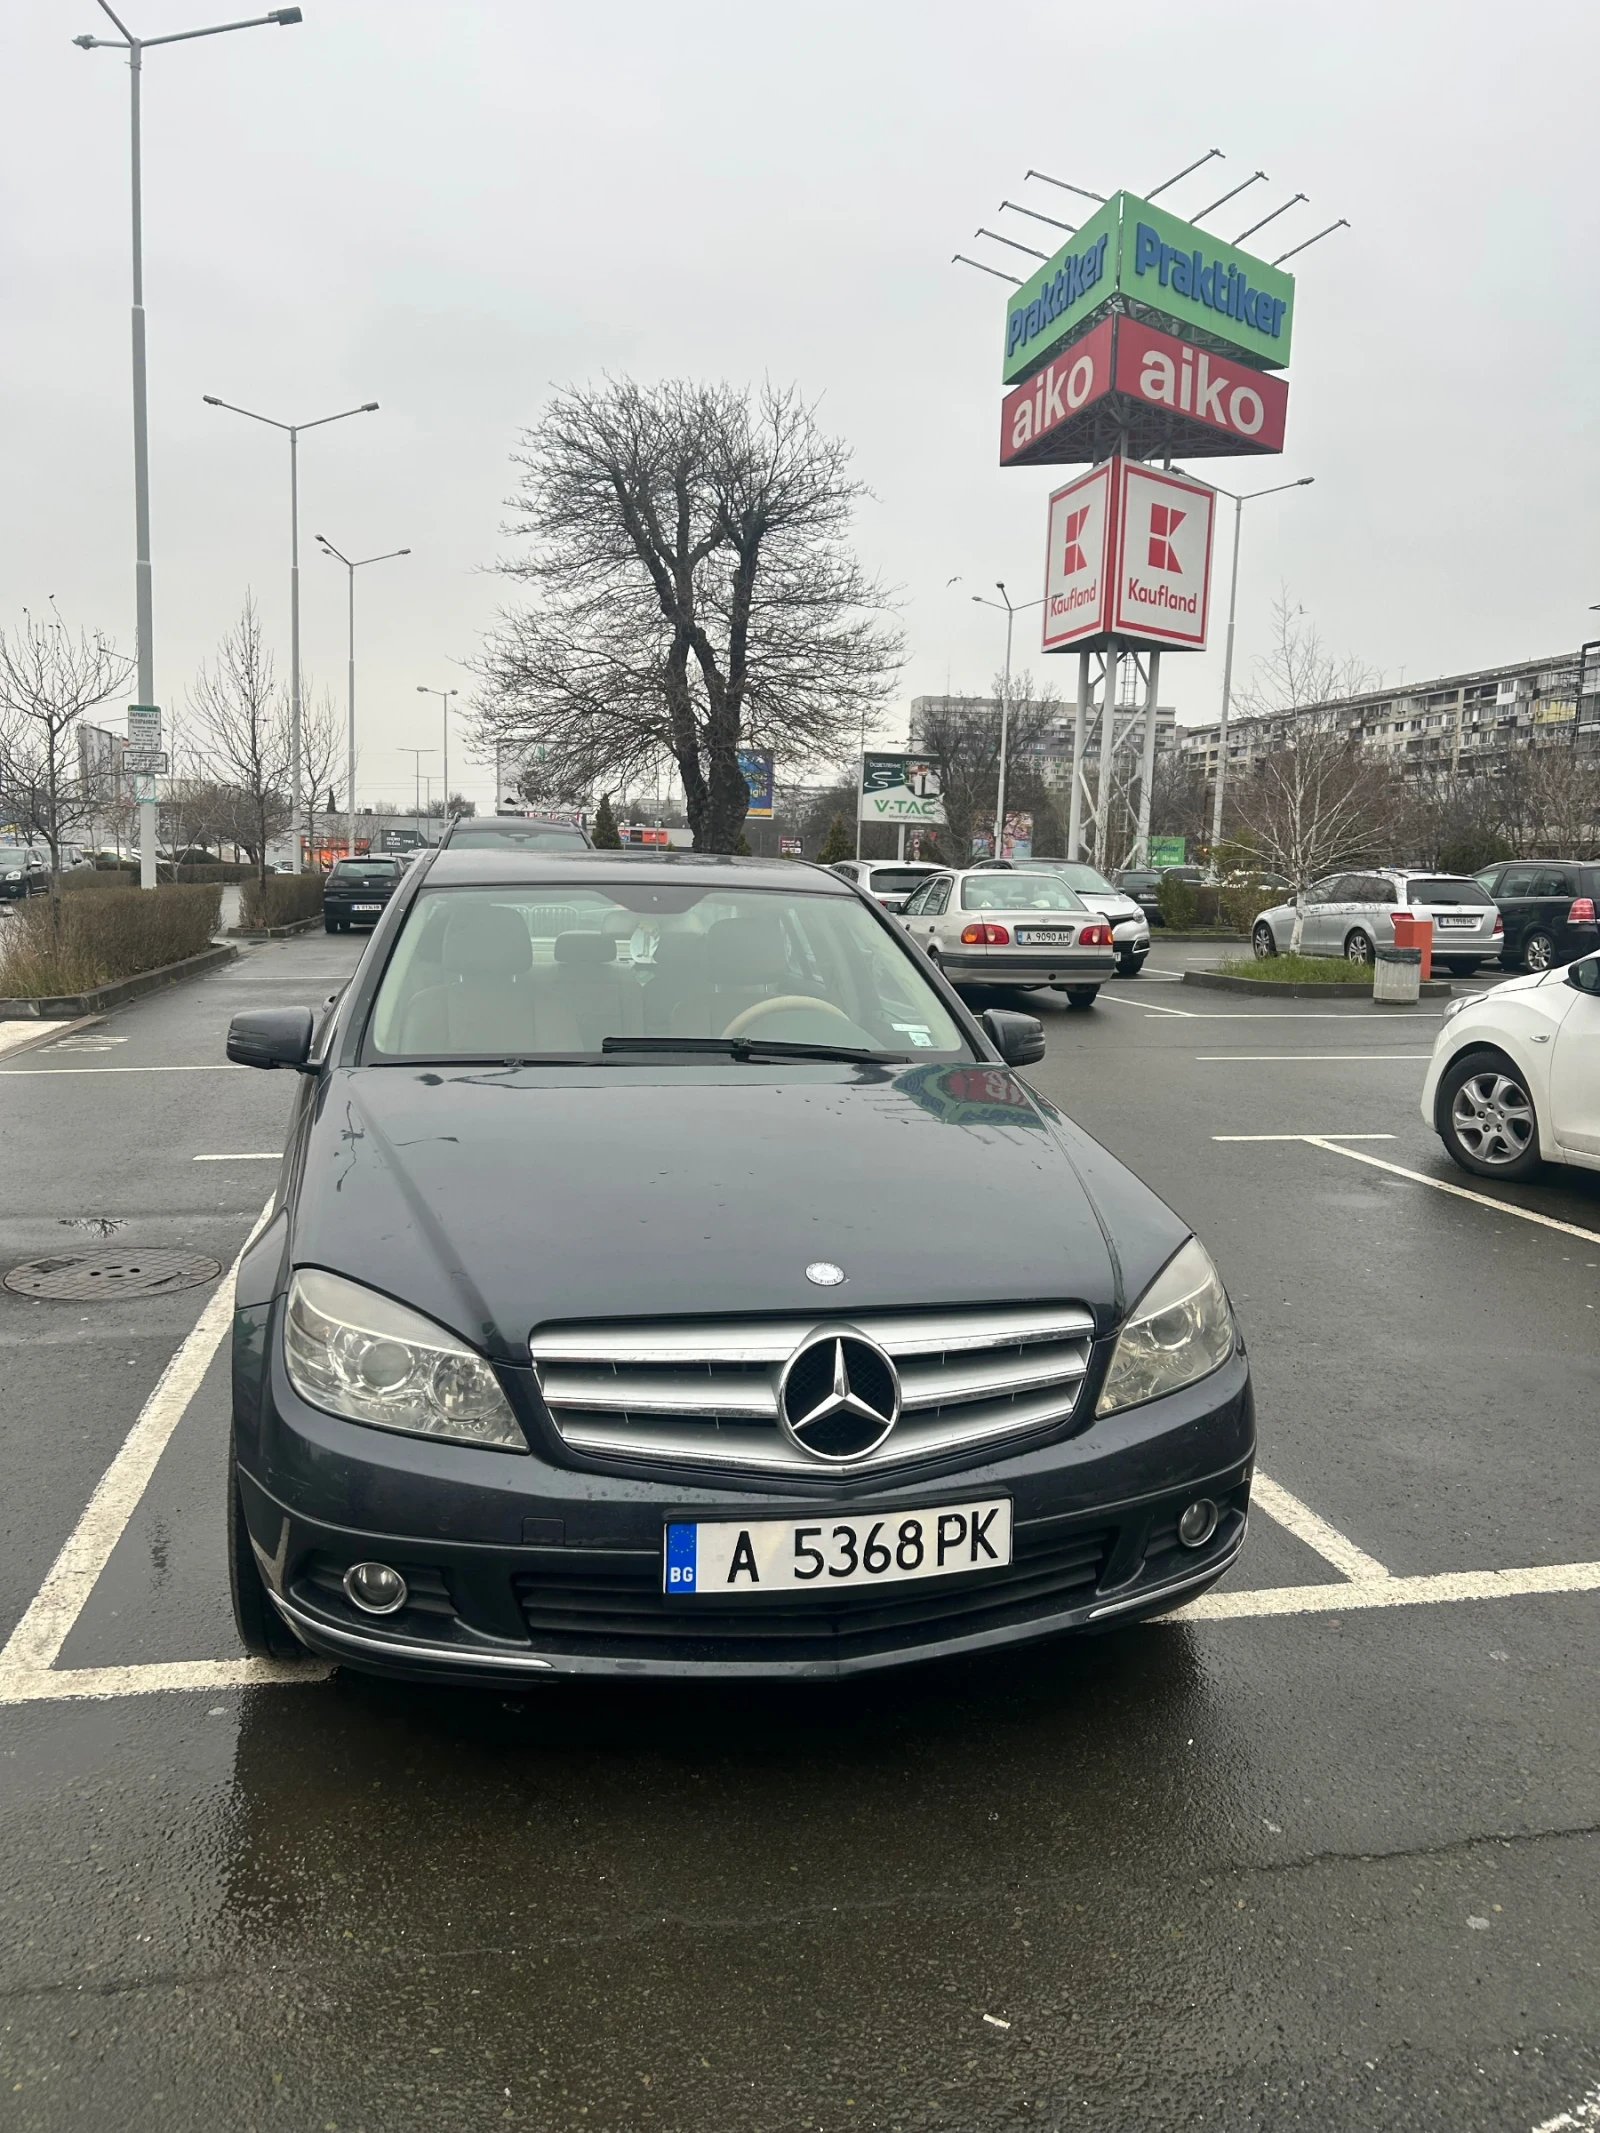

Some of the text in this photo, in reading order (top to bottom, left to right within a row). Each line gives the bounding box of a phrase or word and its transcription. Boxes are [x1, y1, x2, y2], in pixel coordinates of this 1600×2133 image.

[1007, 232, 1109, 358] Praktiker
[1135, 221, 1287, 338] Praktiker
[1011, 355, 1094, 449] aiko
[1139, 346, 1265, 435] aiko
[1050, 578, 1097, 618] Kaufland
[1128, 577, 1198, 614] Kaufland
[874, 799, 936, 815] V-TAC
[1036, 932, 1057, 942] 9090
[670, 1567, 693, 1583] BG
